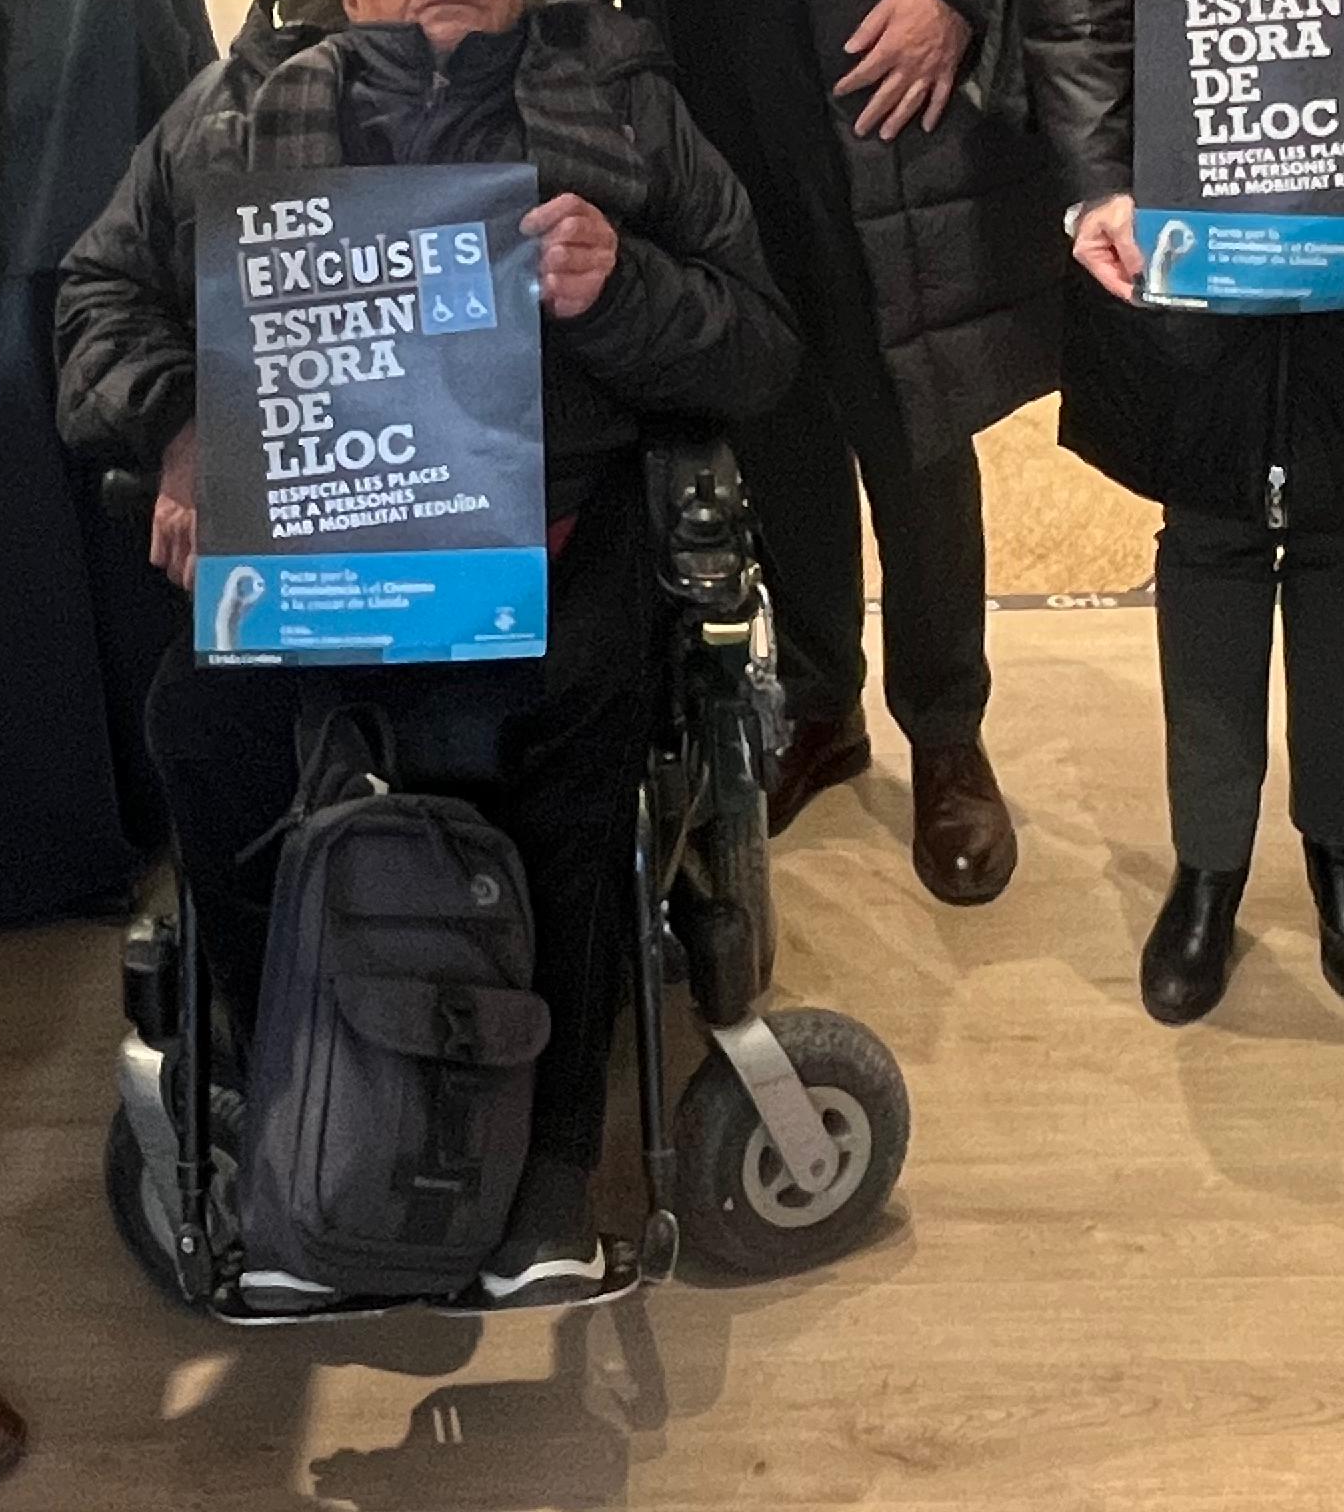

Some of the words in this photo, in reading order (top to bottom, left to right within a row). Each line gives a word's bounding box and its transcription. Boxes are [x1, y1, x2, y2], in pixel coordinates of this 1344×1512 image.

[1187, 21, 1331, 67] FORA
[1191, 67, 1260, 106] DE
[1194, 99, 1339, 145] LLOC
[1198, 148, 1275, 166] RESPECTA
[1279, 145, 1305, 160] LES
[1199, 167, 1228, 182] PER
[1234, 166, 1246, 179] A
[1251, 159, 1337, 177] PERSONES
[1202, 182, 1240, 197] AMB
[1245, 175, 1329, 194] MOBILITAT
[236, 196, 333, 244] LES
[248, 232, 481, 297] EXCUSES
[250, 294, 417, 352] ESTAN
[254, 340, 405, 395] FORA
[259, 392, 333, 438] DE
[262, 424, 415, 480] LLOC
[268, 480, 350, 504] RESPECTA
[355, 475, 383, 492] LES
[388, 465, 449, 488] PLACES
[269, 505, 301, 521] PER
[307, 502, 321, 516] A
[325, 489, 415, 513] PERSONES
[272, 521, 314, 538] AMB
[319, 506, 409, 532] MOBILITAT
[414, 493, 489, 518] REDUÏDA
